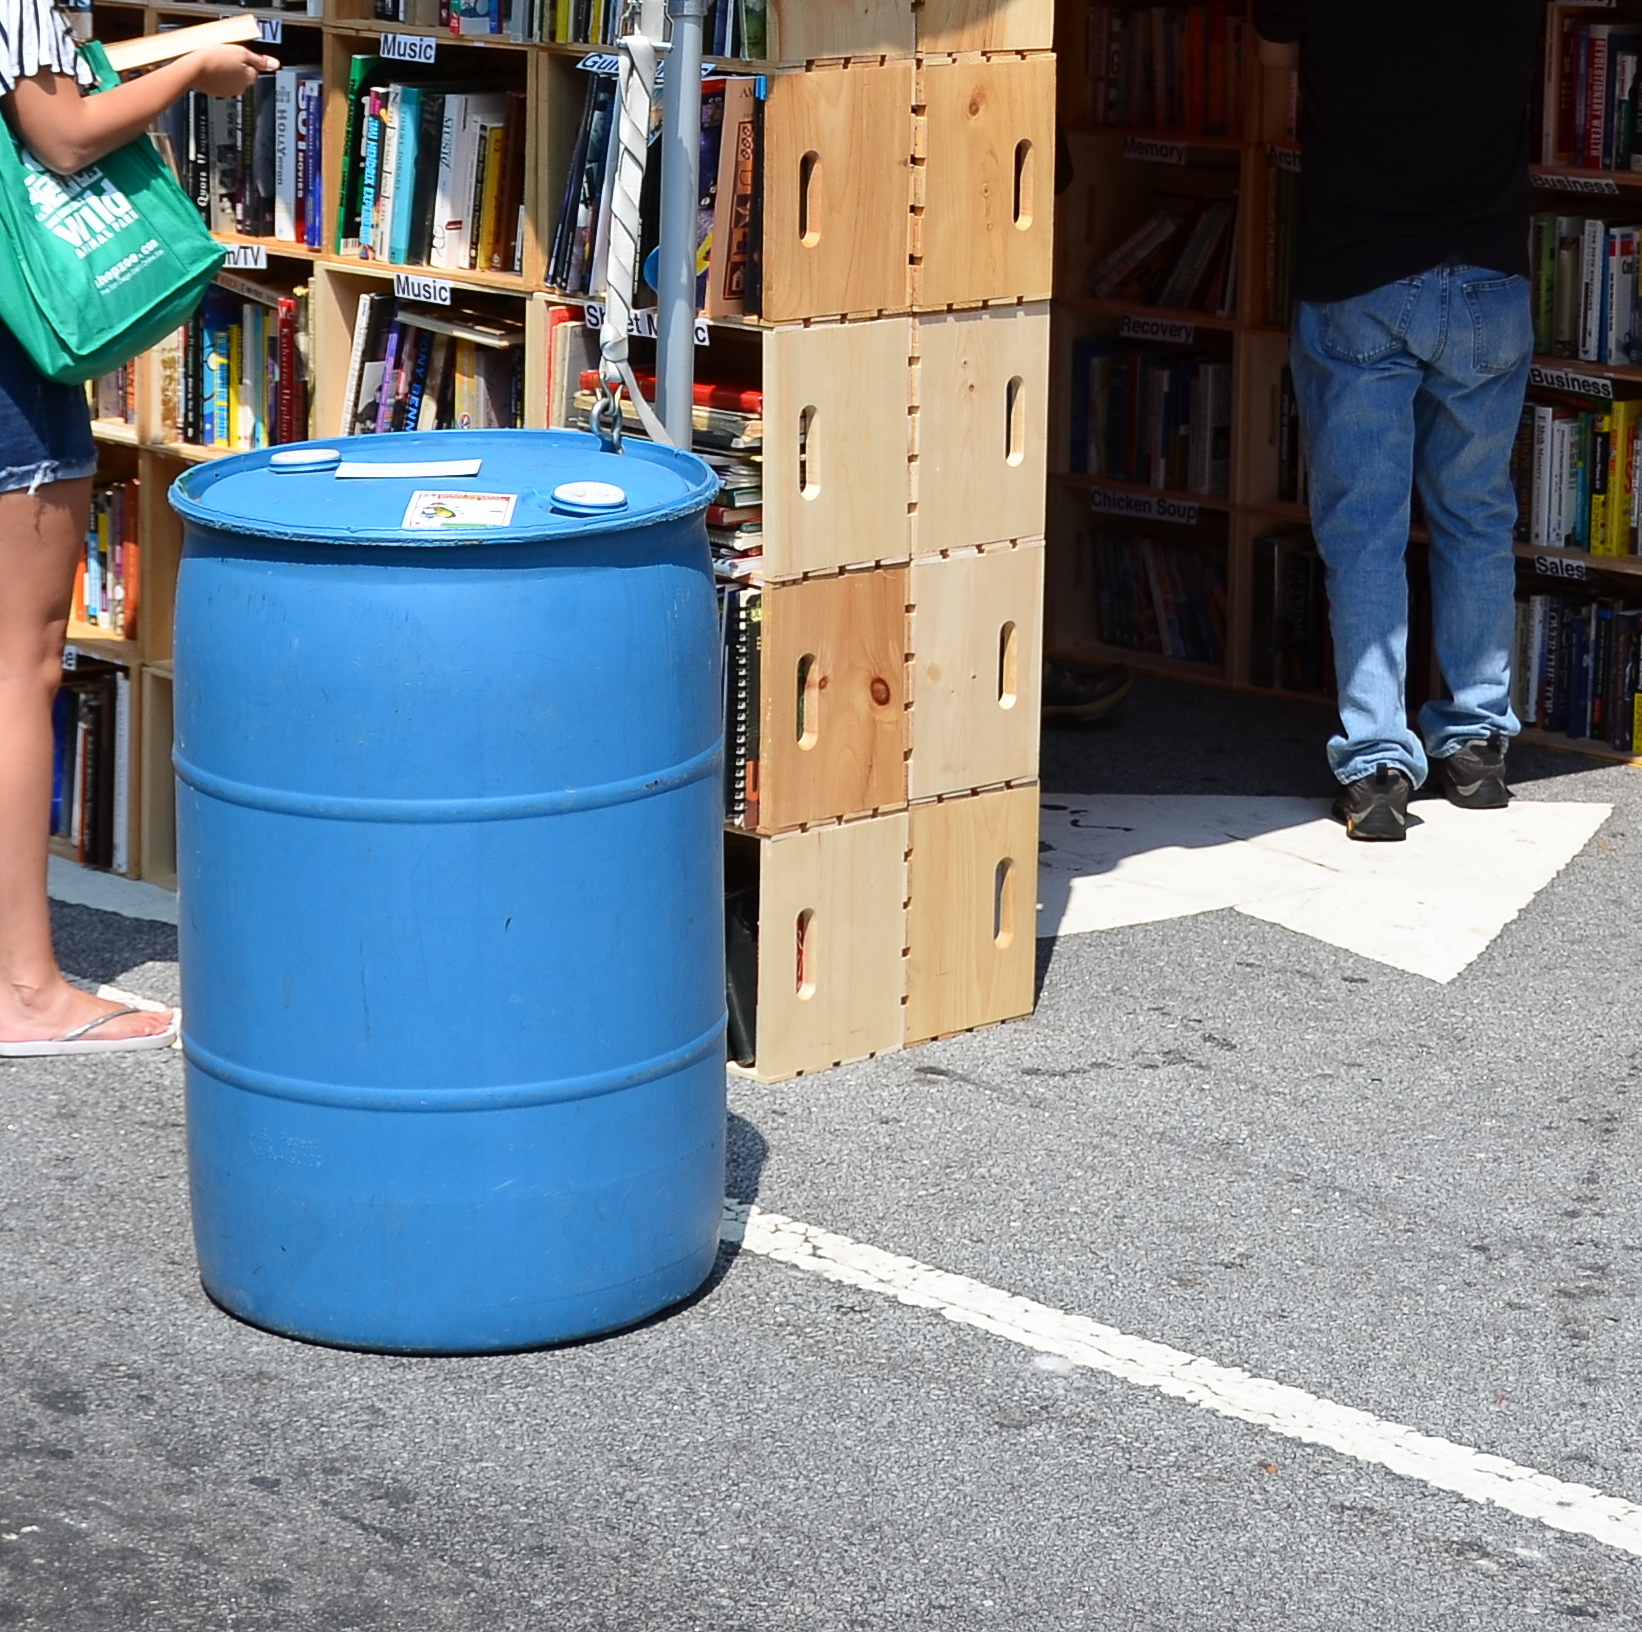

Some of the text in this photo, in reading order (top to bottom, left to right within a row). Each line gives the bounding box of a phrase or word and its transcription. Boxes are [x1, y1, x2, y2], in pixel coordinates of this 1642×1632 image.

[381, 36, 435, 62] Music
[1590, 40, 1605, 156] REVOLUTIONARY WEALTH
[1123, 136, 1185, 161] Memory
[1531, 175, 1617, 194] Business
[224, 246, 261, 266] m/TV
[395, 276, 450, 304] Music
[586, 304, 642, 336] Shet
[1120, 316, 1194, 342] Recovery
[1530, 369, 1612, 397] Business
[405, 383, 423, 432] BENN
[1535, 447, 1544, 481] Mastery
[1092, 488, 1198, 522] Chicken Soup
[1536, 556, 1586, 579] Sales
[1544, 612, 1558, 713] OVER THE TOP
